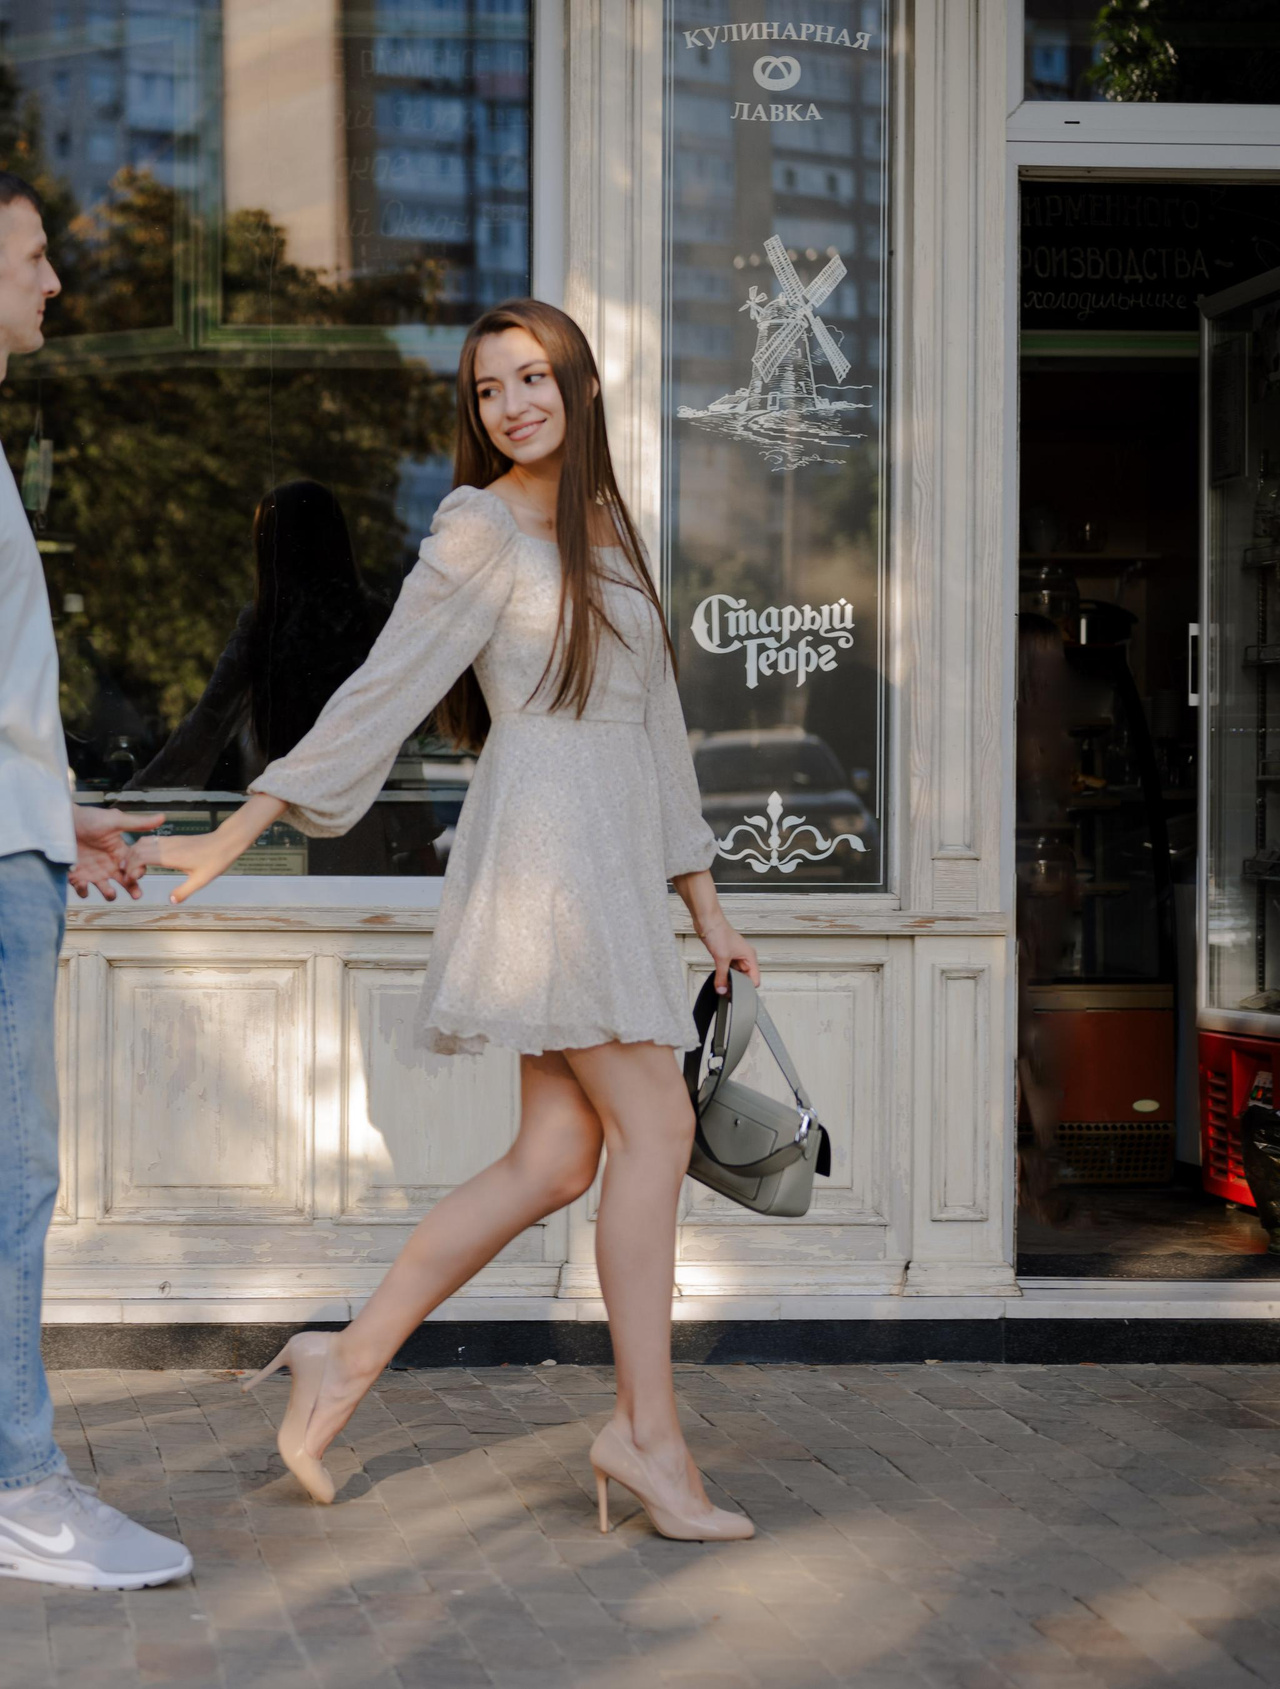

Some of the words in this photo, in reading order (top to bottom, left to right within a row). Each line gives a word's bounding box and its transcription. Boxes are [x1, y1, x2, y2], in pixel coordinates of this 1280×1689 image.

[683, 22, 872, 50] КУЛИНАРНАЯ
[730, 102, 823, 122] ЛАВКА
[1022, 194, 1200, 229] ИРМЕННОГО
[1021, 245, 1210, 283] РОИЗВОДСТВА
[690, 594, 855, 654] Старый
[743, 636, 838, 689] Георг
